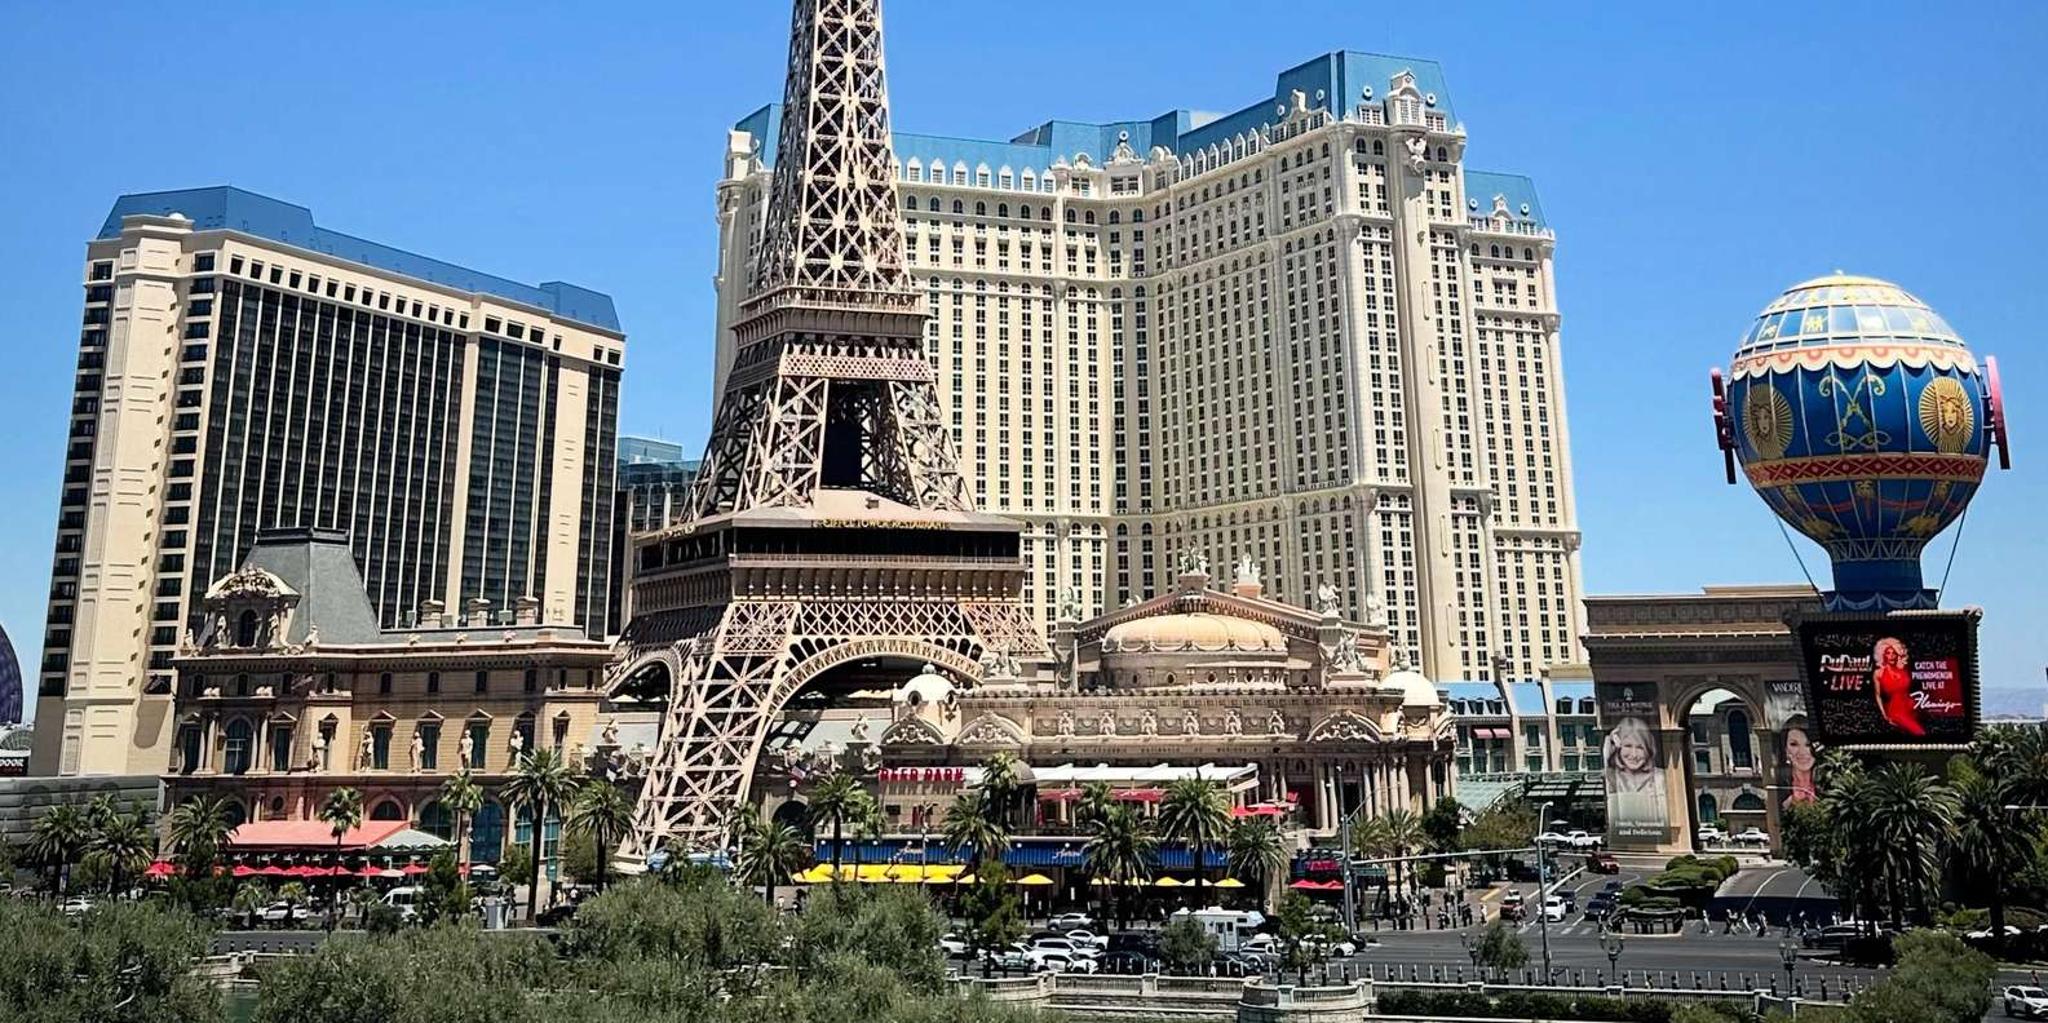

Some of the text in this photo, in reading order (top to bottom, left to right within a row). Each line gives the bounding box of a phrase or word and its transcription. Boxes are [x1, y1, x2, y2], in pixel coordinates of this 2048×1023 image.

[1819, 654, 1872, 672] RuPaul
[1914, 661, 1947, 670] CATCH THE
[1830, 675, 1864, 690] LIVE
[1922, 681, 1936, 690] LIVE
[1910, 691, 1962, 712] Flamingo
[879, 768, 964, 782] BEER PARK
